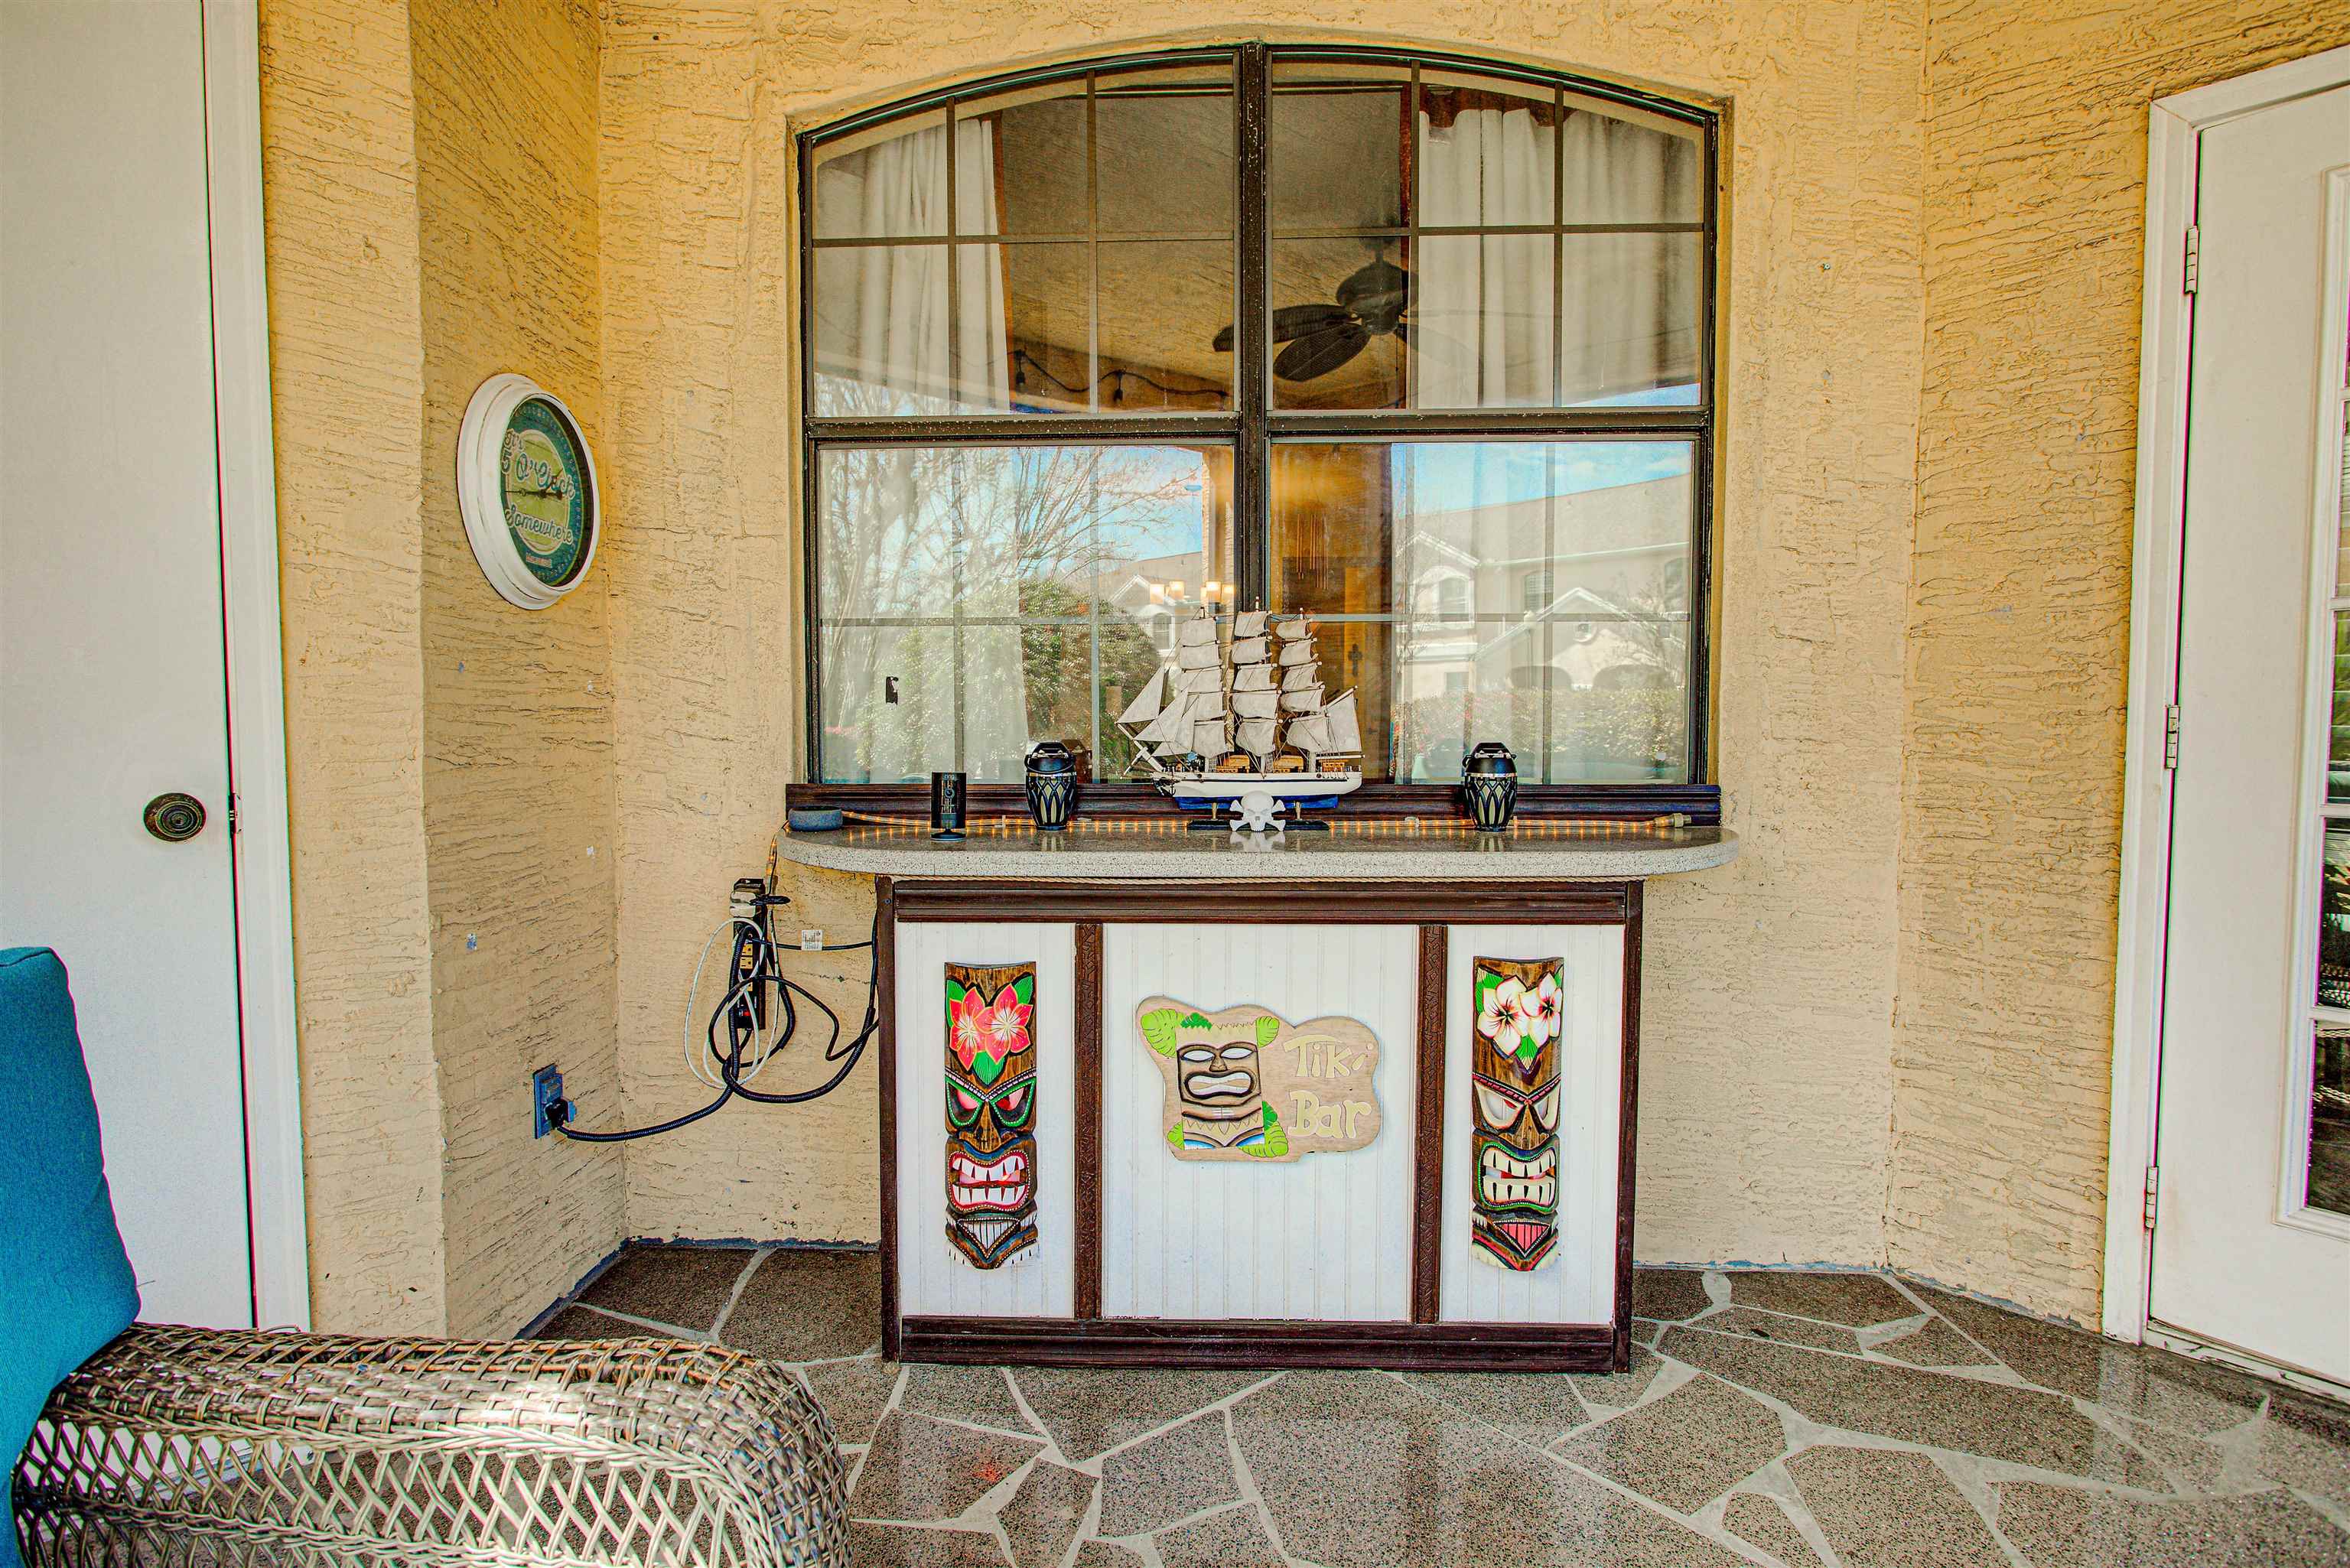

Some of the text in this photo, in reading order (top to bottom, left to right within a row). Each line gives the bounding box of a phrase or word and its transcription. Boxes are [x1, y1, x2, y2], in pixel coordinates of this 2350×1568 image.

[505, 504, 574, 544] Somewhere
[1283, 1034, 1375, 1078] Tiki
[1287, 1089, 1372, 1139] Bar
